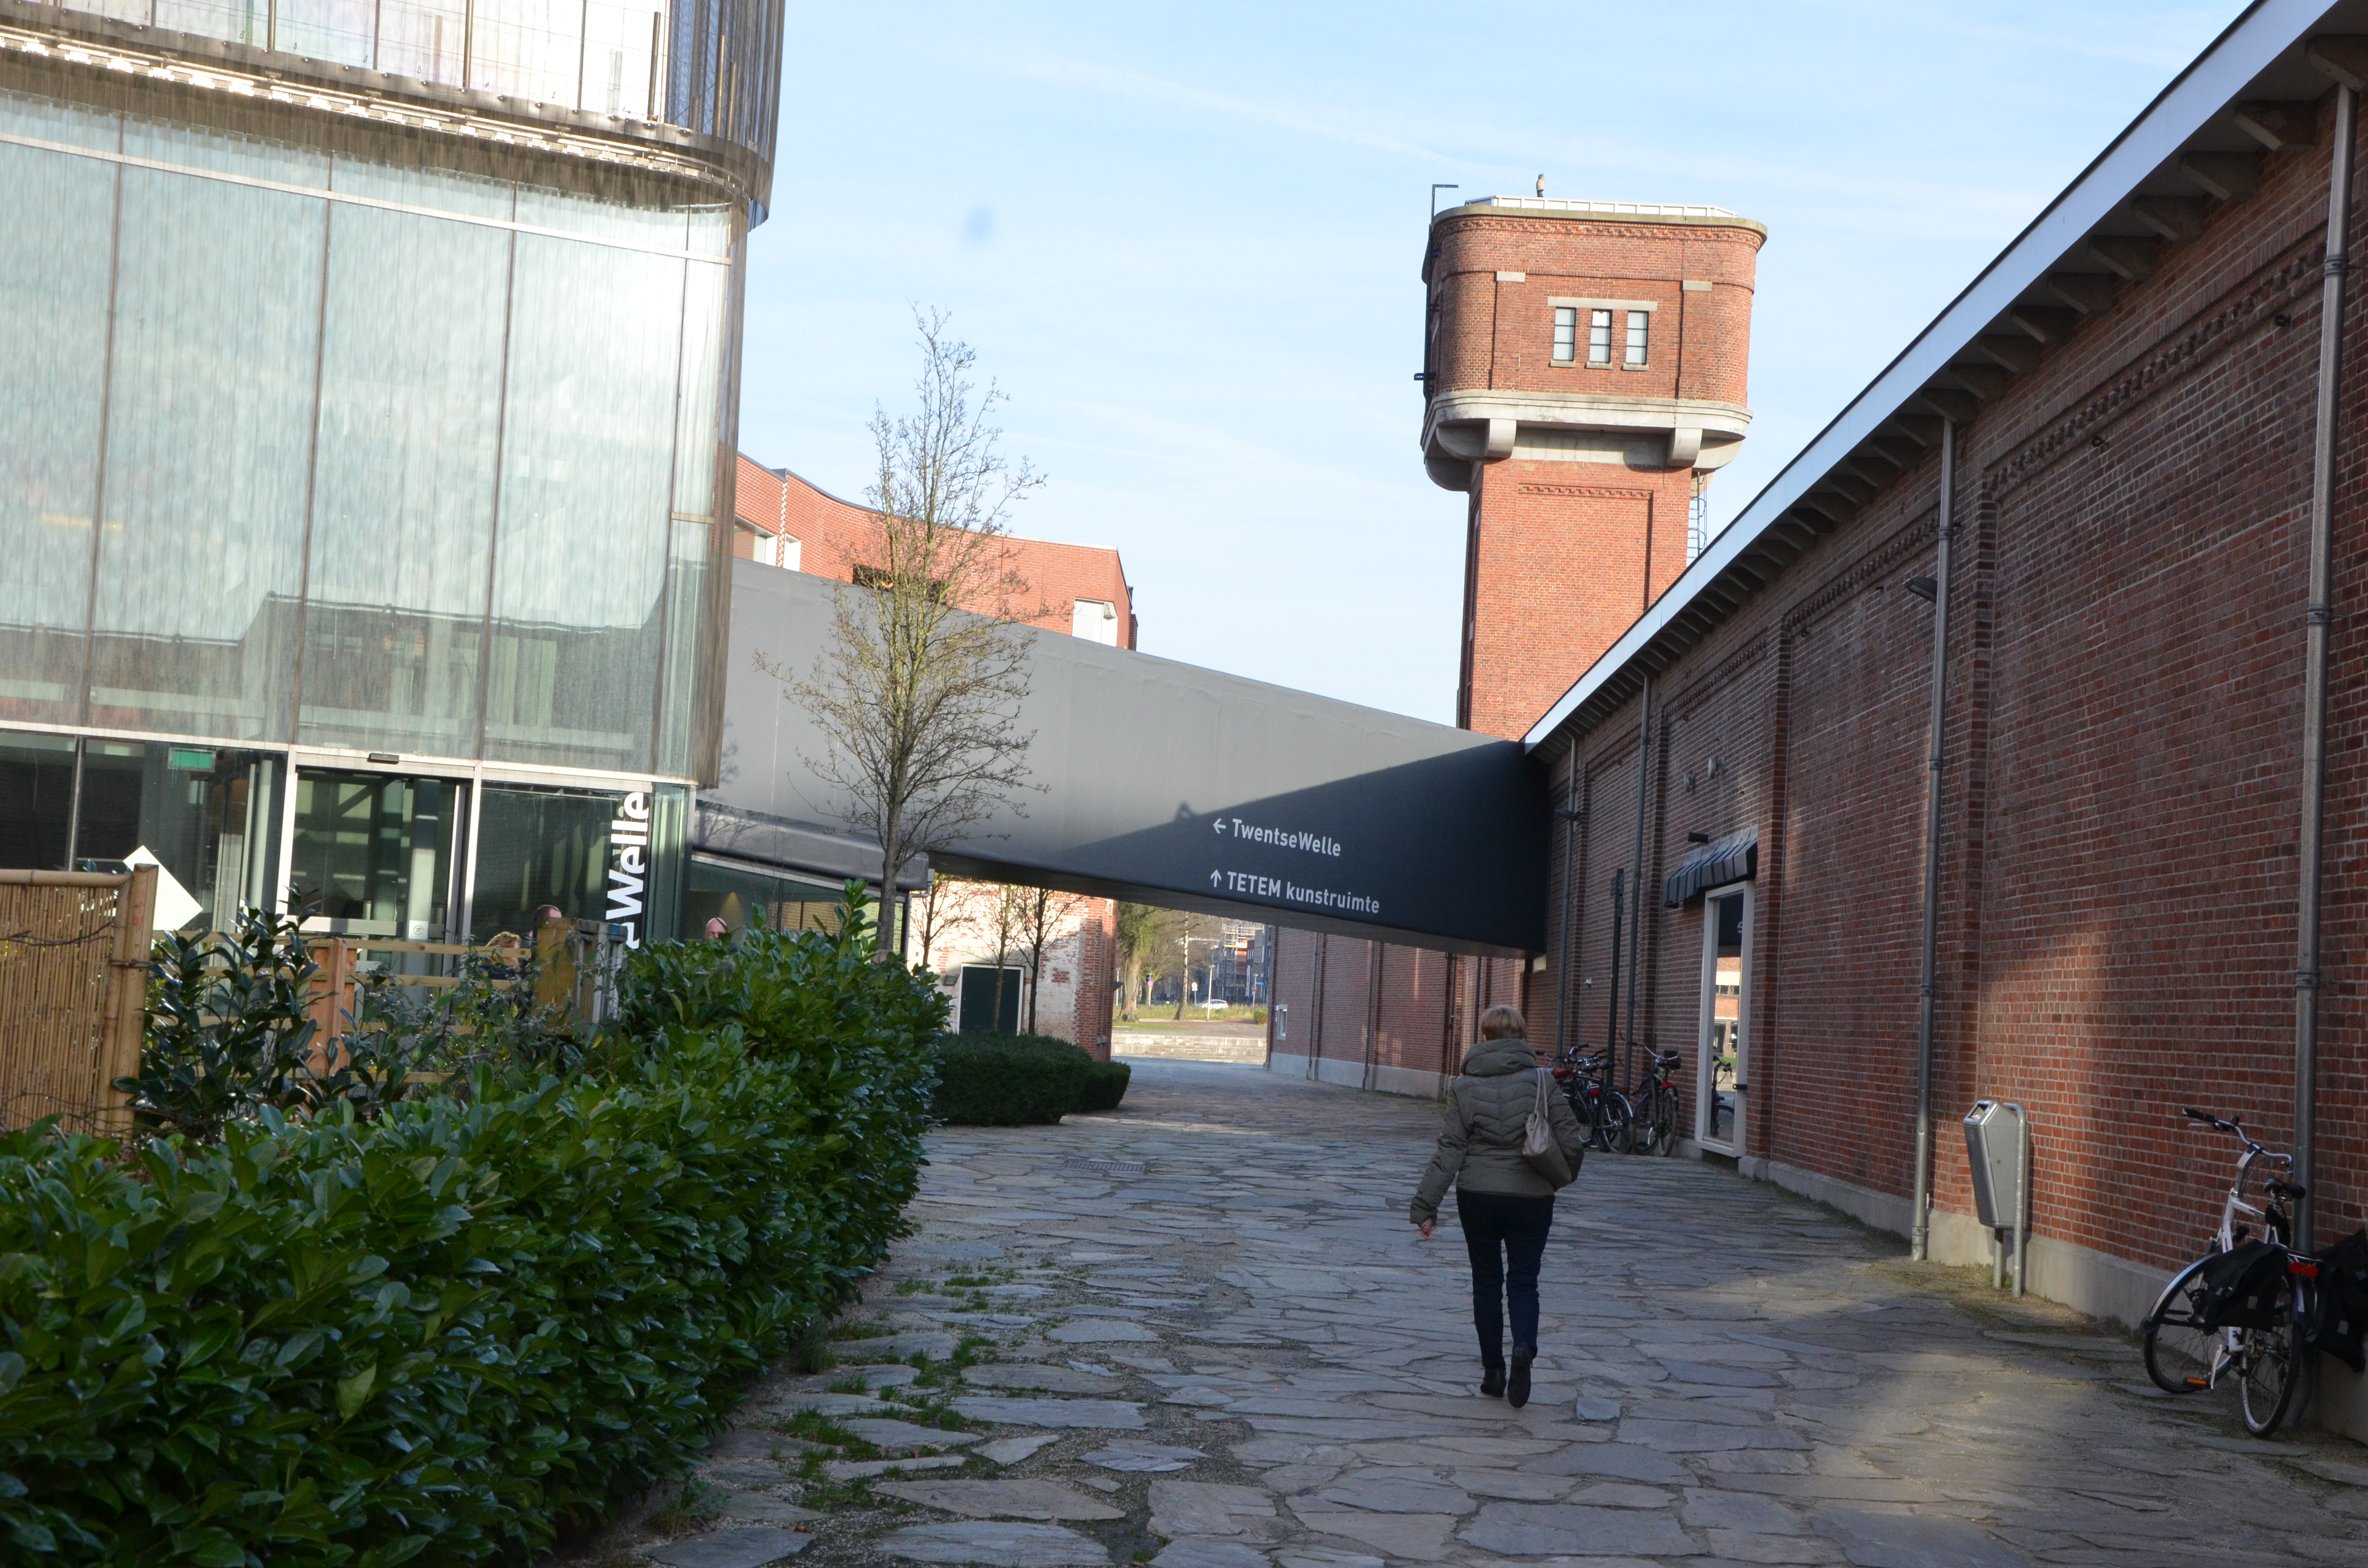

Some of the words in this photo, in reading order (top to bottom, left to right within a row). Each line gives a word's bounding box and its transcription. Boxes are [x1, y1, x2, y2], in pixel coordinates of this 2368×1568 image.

[1232, 818, 1341, 857] TwentseWelle
[1227, 871, 1281, 897] TETEM
[1286, 882, 1380, 913] kunstruimte
